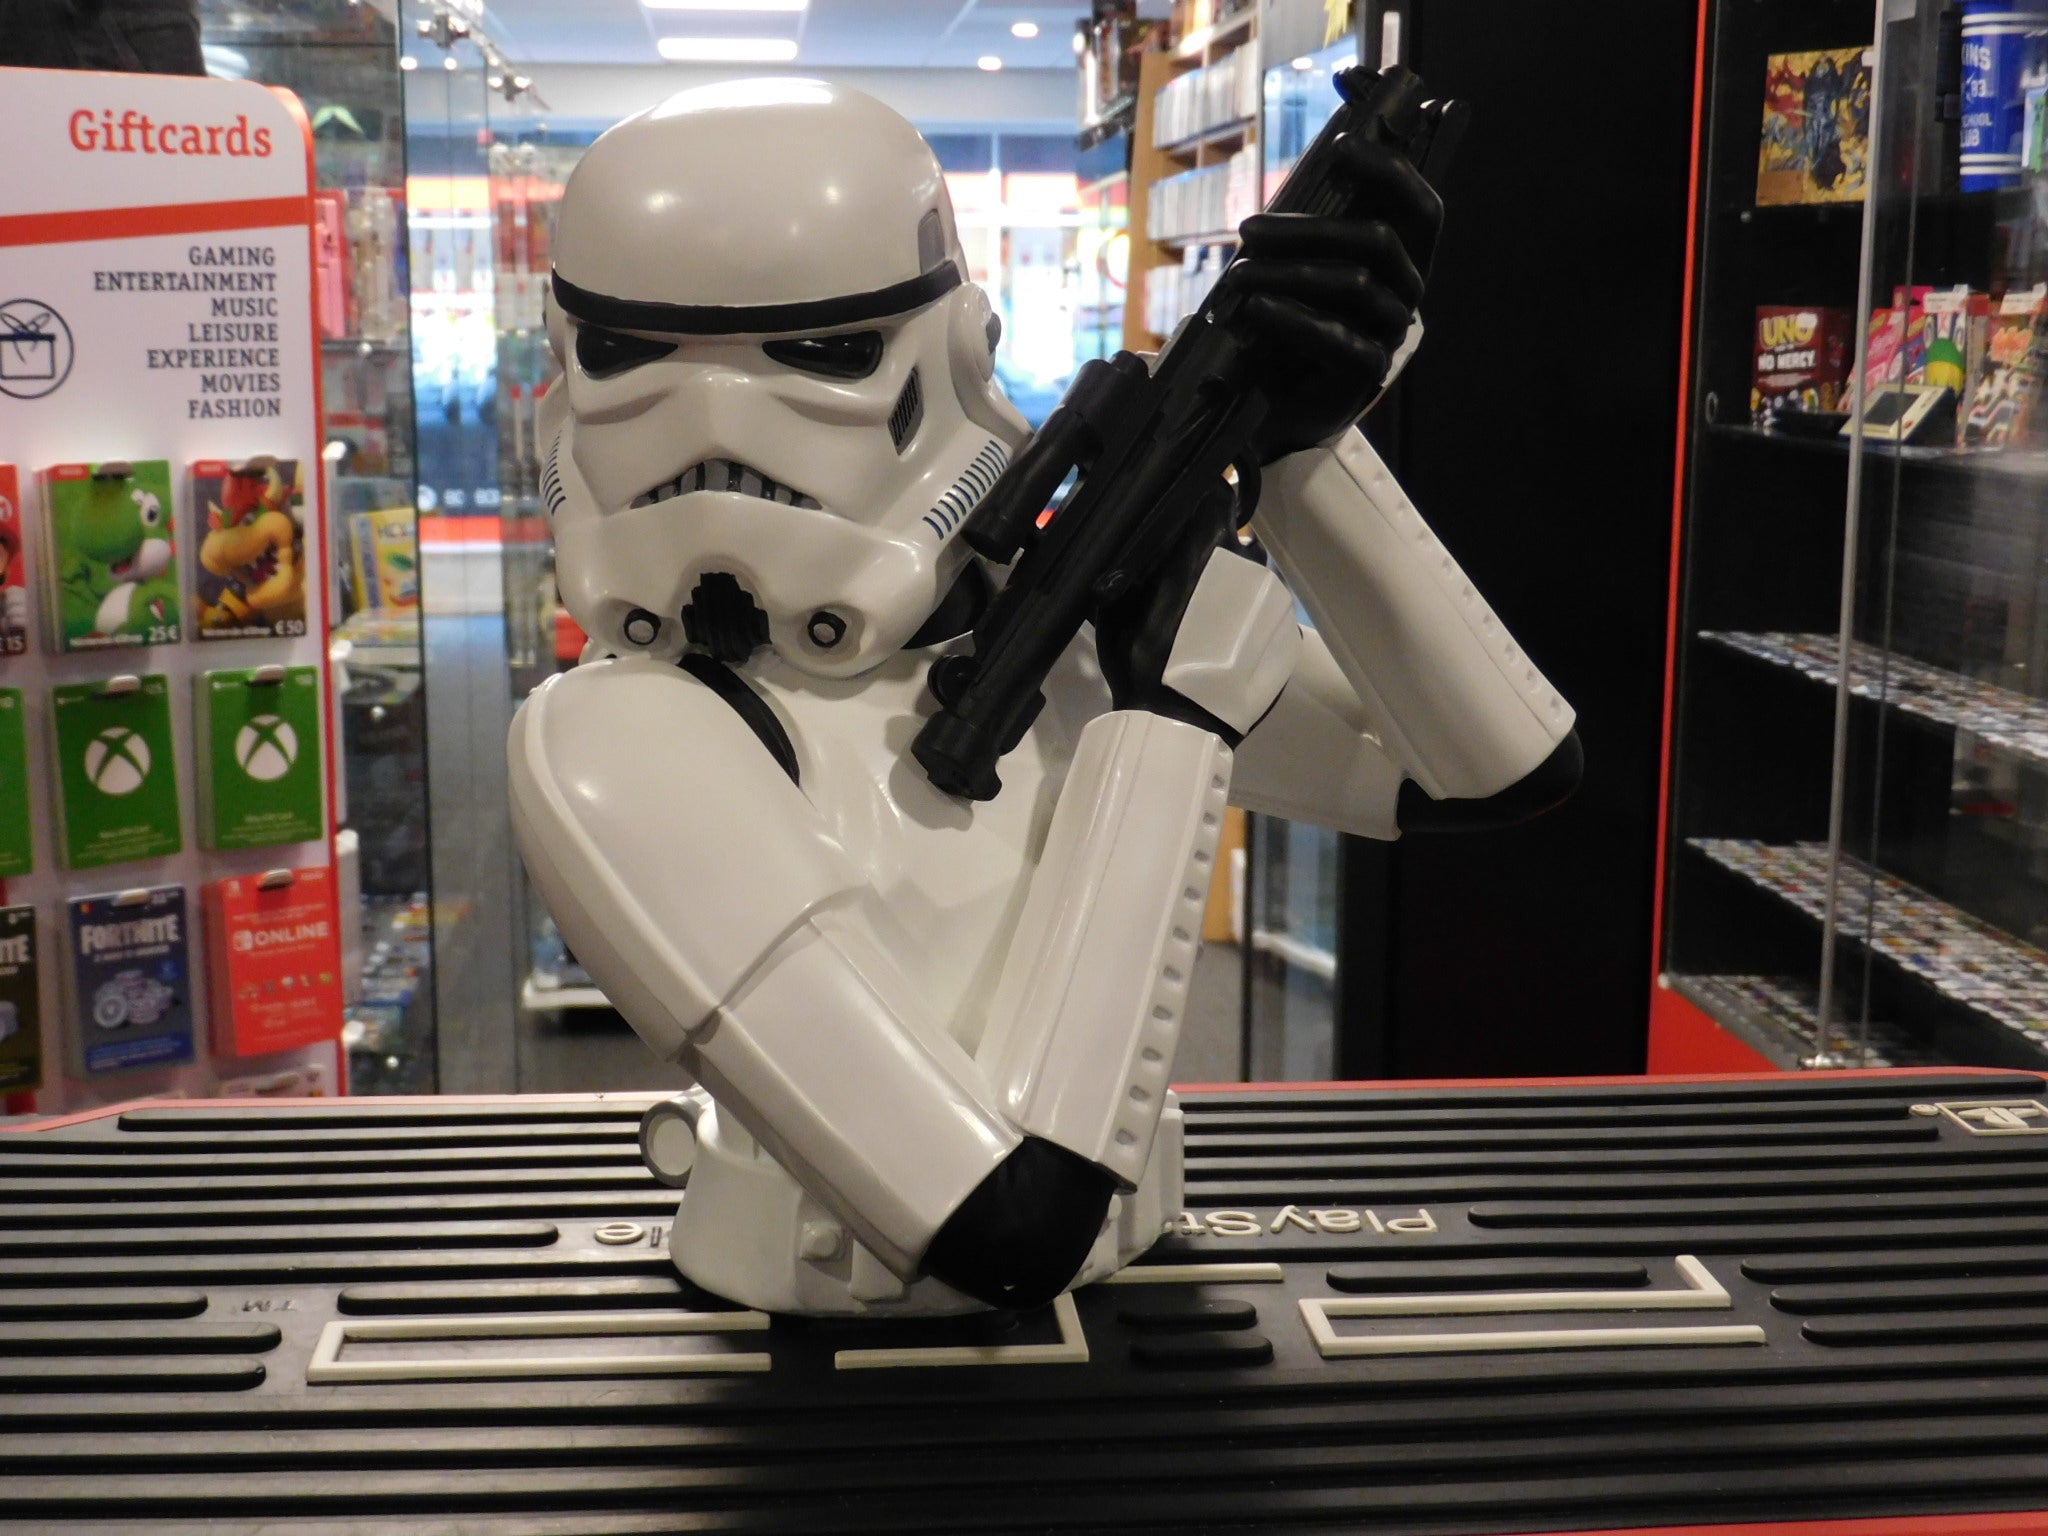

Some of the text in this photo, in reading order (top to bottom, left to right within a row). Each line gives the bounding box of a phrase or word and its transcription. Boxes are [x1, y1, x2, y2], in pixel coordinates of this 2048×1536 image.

[69, 109, 273, 158] Giftcards
[188, 246, 276, 267] GAMING
[93, 271, 277, 293] ENTERTAINMENT
[210, 297, 279, 318] MUSIC
[188, 322, 280, 343] LEISURE
[1760, 314, 1818, 349] UNO
[146, 348, 281, 369] EXPERIENCE
[1758, 354, 1775, 371] NO
[200, 373, 281, 394] MOVIES
[188, 398, 282, 419] FASHION
[81, 913, 180, 955] FORTNITE
[255, 921, 329, 945] ONLINE
